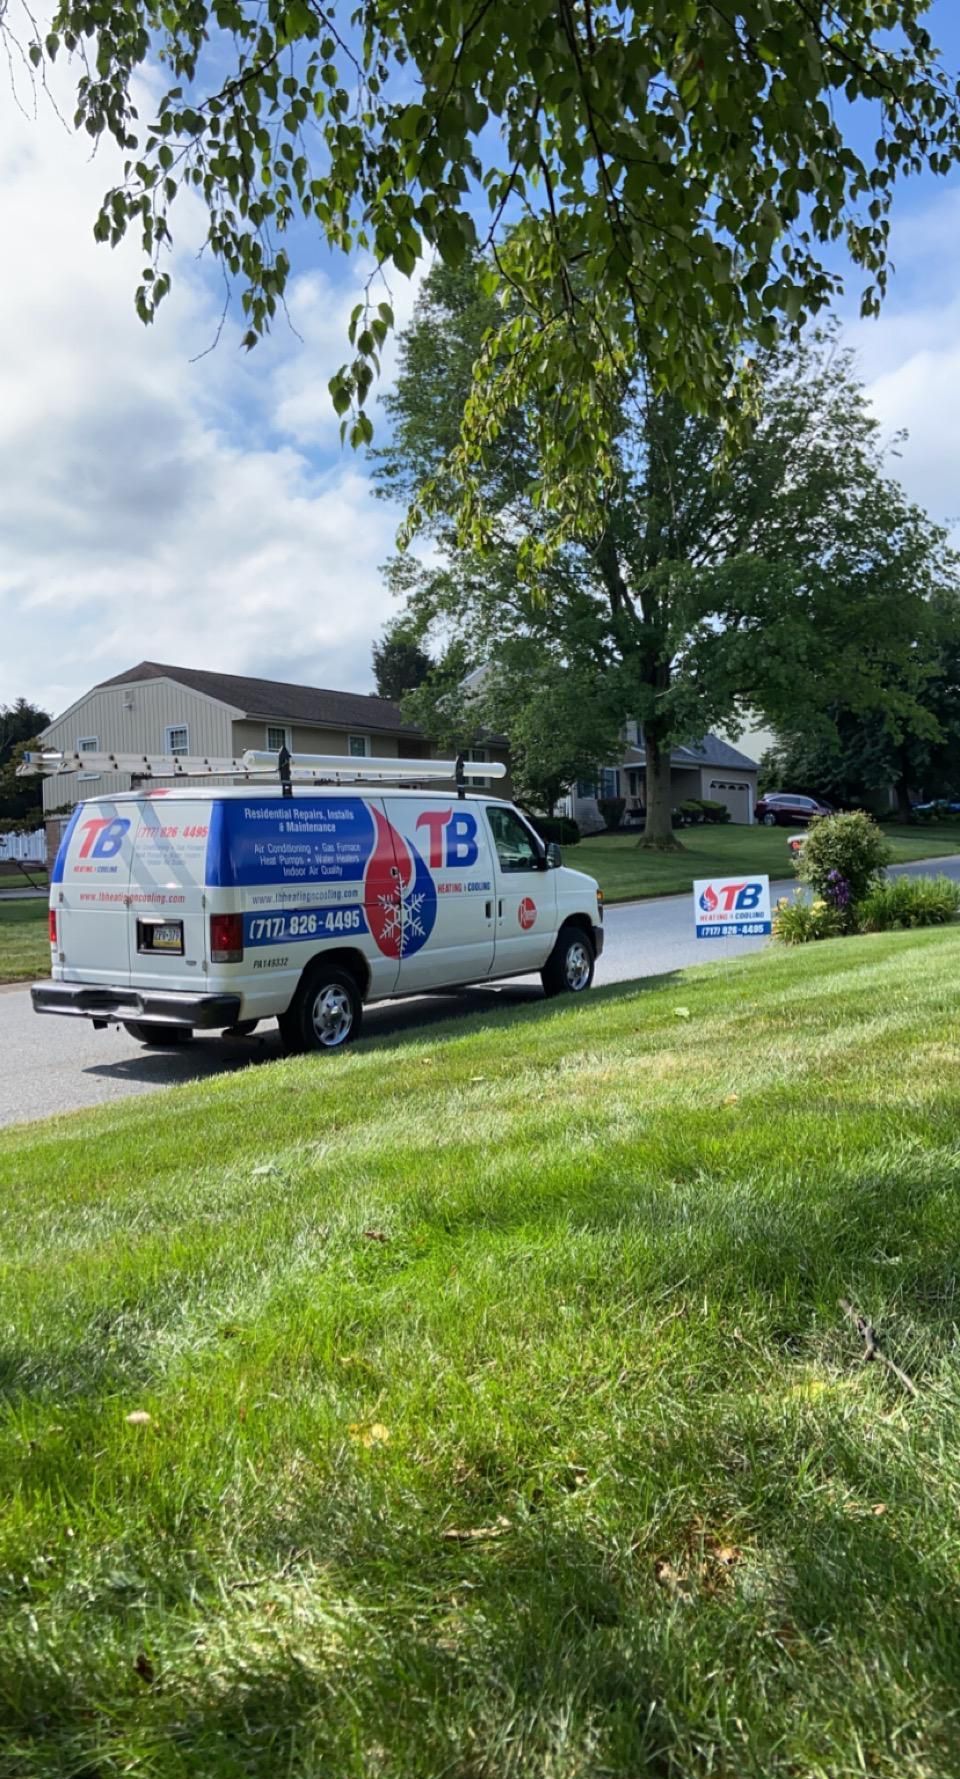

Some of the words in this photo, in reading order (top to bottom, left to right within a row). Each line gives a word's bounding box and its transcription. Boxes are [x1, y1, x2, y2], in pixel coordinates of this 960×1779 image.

[244, 808, 291, 819] Residential
[294, 809, 326, 820] Repairs,
[328, 809, 354, 819] Installs
[286, 822, 336, 832] Maintenance
[78, 818, 131, 859] TB
[415, 807, 478, 868] TB
[254, 843, 264, 853] Air
[268, 843, 311, 855] Conditioning
[322, 842, 335, 851] Gas
[337, 842, 361, 852] Furnace
[261, 855, 276, 866] Heat
[279, 855, 304, 867] Pumps
[315, 855, 334, 864] Water
[337, 854, 360, 863] Heaters
[283, 866, 306, 877] Indoor
[309, 866, 318, 876] Air
[321, 866, 343, 877] Quality
[437, 883, 462, 893] HEATING
[467, 881, 491, 892] COOLING
[719, 881, 763, 911] TB
[700, 913, 728, 922] HEATING
[735, 911, 765, 920] COOLING
[250, 917, 285, 940] (717)
[702, 926, 721, 937] (717)
